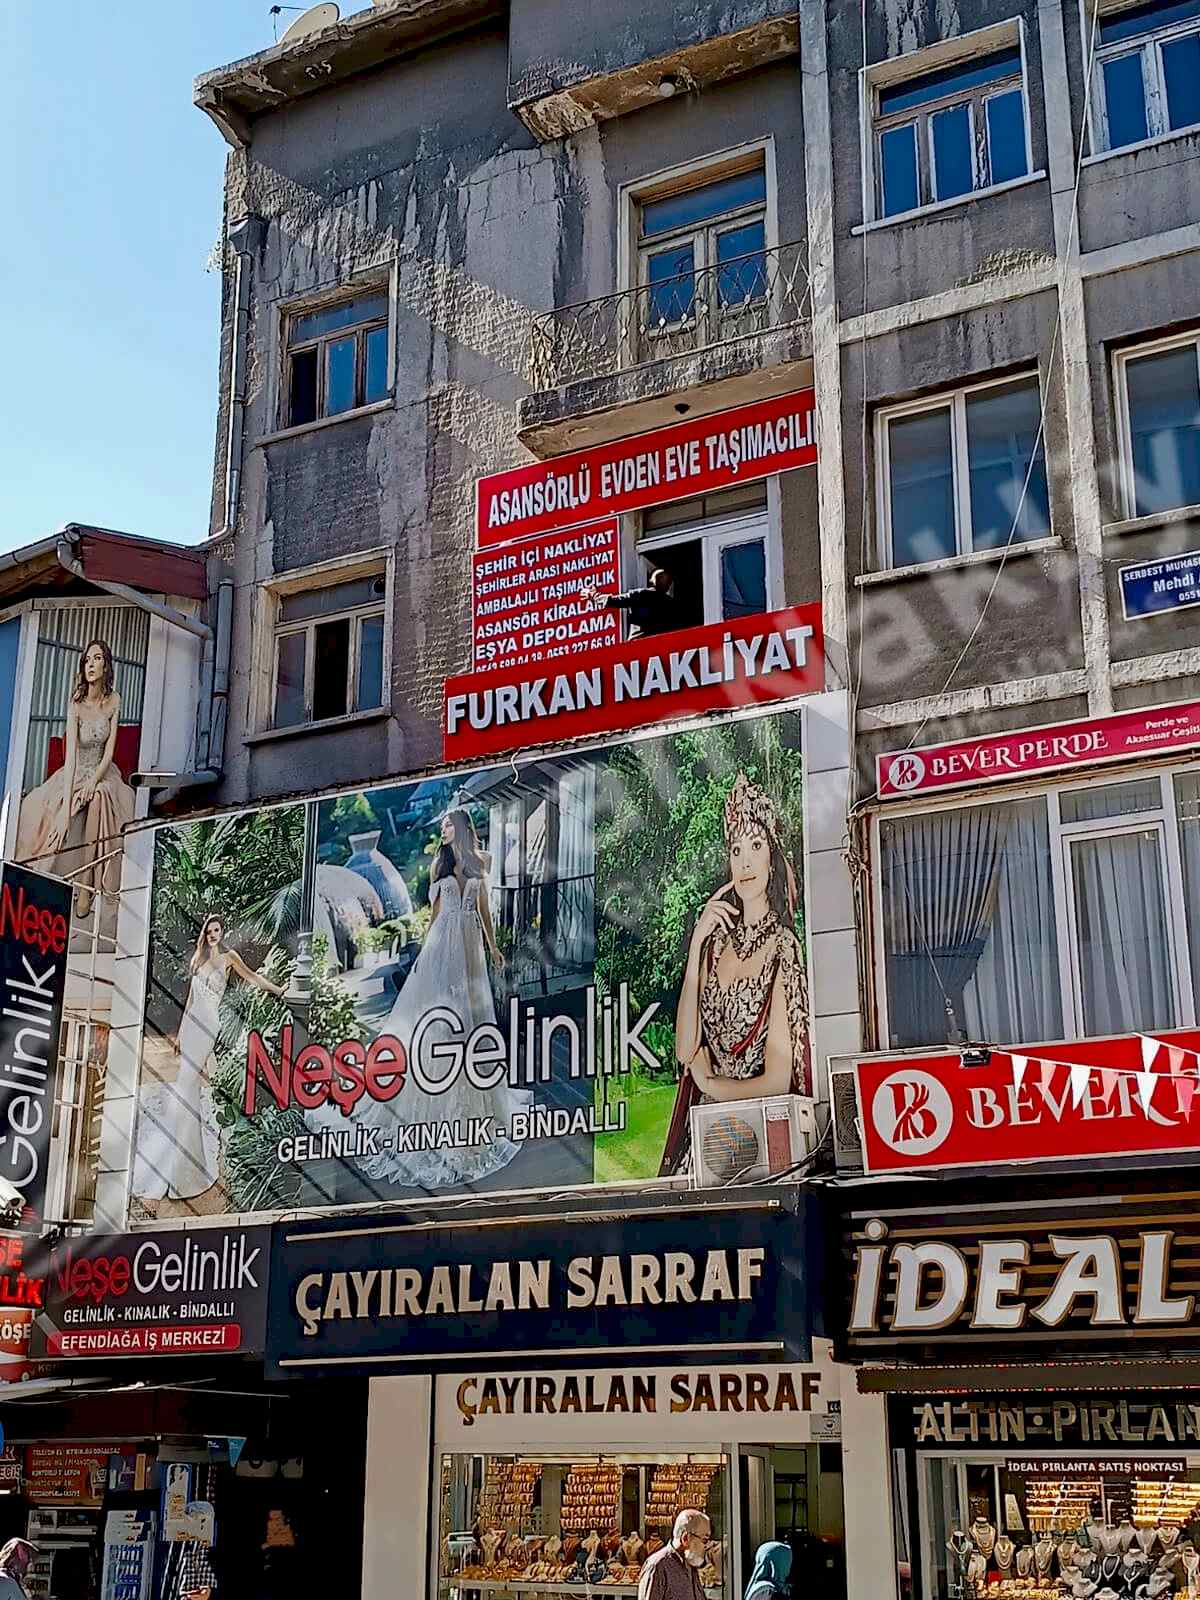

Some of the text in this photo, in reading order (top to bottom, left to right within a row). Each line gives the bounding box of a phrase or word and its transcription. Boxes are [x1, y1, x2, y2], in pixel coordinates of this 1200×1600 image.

[488, 463, 591, 528] ASANSÖRLÜ
[600, 450, 660, 499] EVDEN
[666, 438, 700, 482] EVE
[475, 530, 614, 580] ŞEHİR İÇİ NAKLİYAT
[476, 550, 615, 598] ŞEHİRLER ARASI NAKLİYAT
[1124, 557, 1200, 582] SERBEST MUHAS
[476, 569, 615, 617] AMBALAJLI TAŞIMACILIK
[1153, 573, 1195, 593] Mehdi
[476, 612, 540, 640] ASANSÖR
[476, 613, 616, 661] EŞYA DEPOLAMA
[447, 625, 814, 735] FURKAN NAKLİYAT
[1145, 716, 1189, 731] Perde ve
[930, 744, 1021, 777] BEVER
[1017, 730, 1109, 764] PERDE
[1, 881, 67, 955] Neşe
[0, 954, 55, 1189] Gelinlik
[243, 982, 662, 1117] Neşe Gelinlik
[276, 1126, 379, 1163] GELİNLİK
[397, 1117, 491, 1155] KINALIK
[510, 1102, 626, 1141] BİNDALLI
[52, 1233, 261, 1304] Neşe Gelinlik
[296, 1247, 766, 1335] ÇAYIRALAN SARRAF
[848, 1217, 1195, 1332] İDEAL
[0, 1319, 32, 1345] ÖŞE
[63, 1304, 115, 1324] GELİNLİK
[124, 1304, 171, 1321] KINALIK
[180, 1300, 234, 1318] BİNDALLI
[61, 1326, 226, 1350] EFENDİAĞA İŞ MERKEZİ
[456, 1372, 822, 1426] ÇAYIRALAN SARRAF
[915, 1401, 1026, 1442] ALTIN
[1007, 1460, 1185, 1475] İDEAL PIRLANTA SATIŞ NOKTASI
